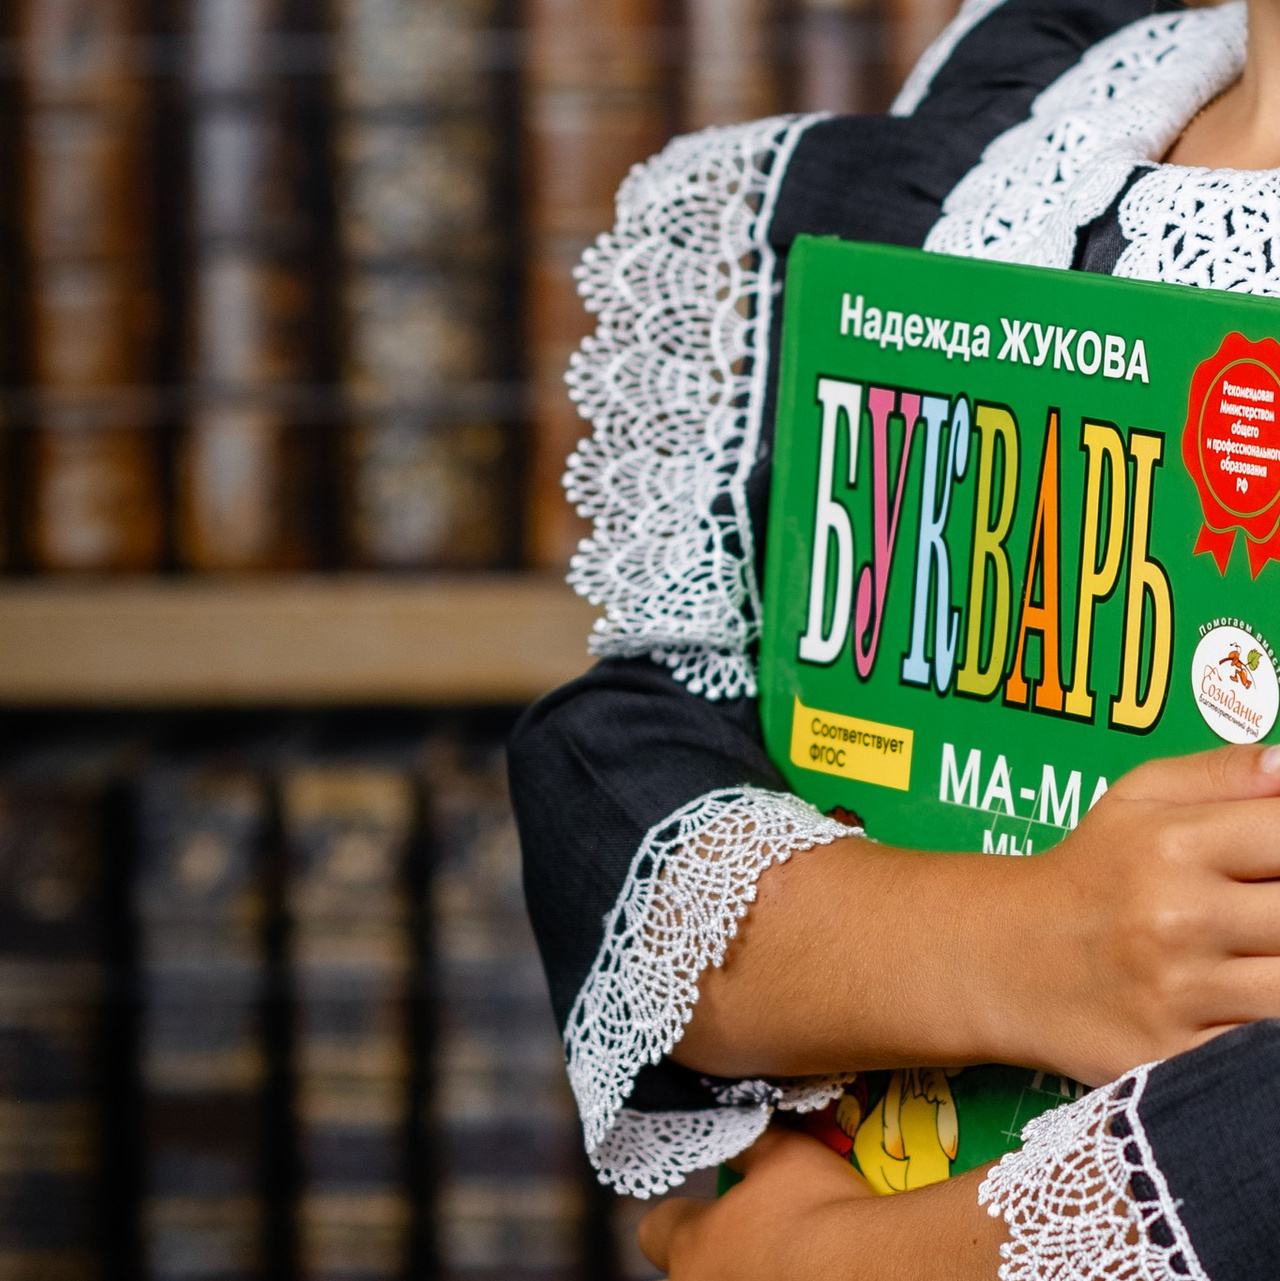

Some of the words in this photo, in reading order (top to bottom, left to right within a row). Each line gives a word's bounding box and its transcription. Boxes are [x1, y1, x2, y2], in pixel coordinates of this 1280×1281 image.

[840, 293, 990, 361] Надежда
[997, 317, 1150, 384] ЖУКОВА
[1223, 380, 1274, 402] Рекомендован
[1220, 399, 1275, 422] Министерством
[1231, 419, 1259, 438] общего
[1206, 437, 1212, 449] и
[1220, 455, 1267, 477] образования
[1236, 477, 1248, 494] РФ
[798, 375, 1175, 737] БУКВАРЬ
[1198, 617, 1253, 637] Помогаем
[1201, 664, 1263, 727] Созидание
[811, 717, 905, 755] Соответствует
[809, 743, 847, 768] ФГОС
